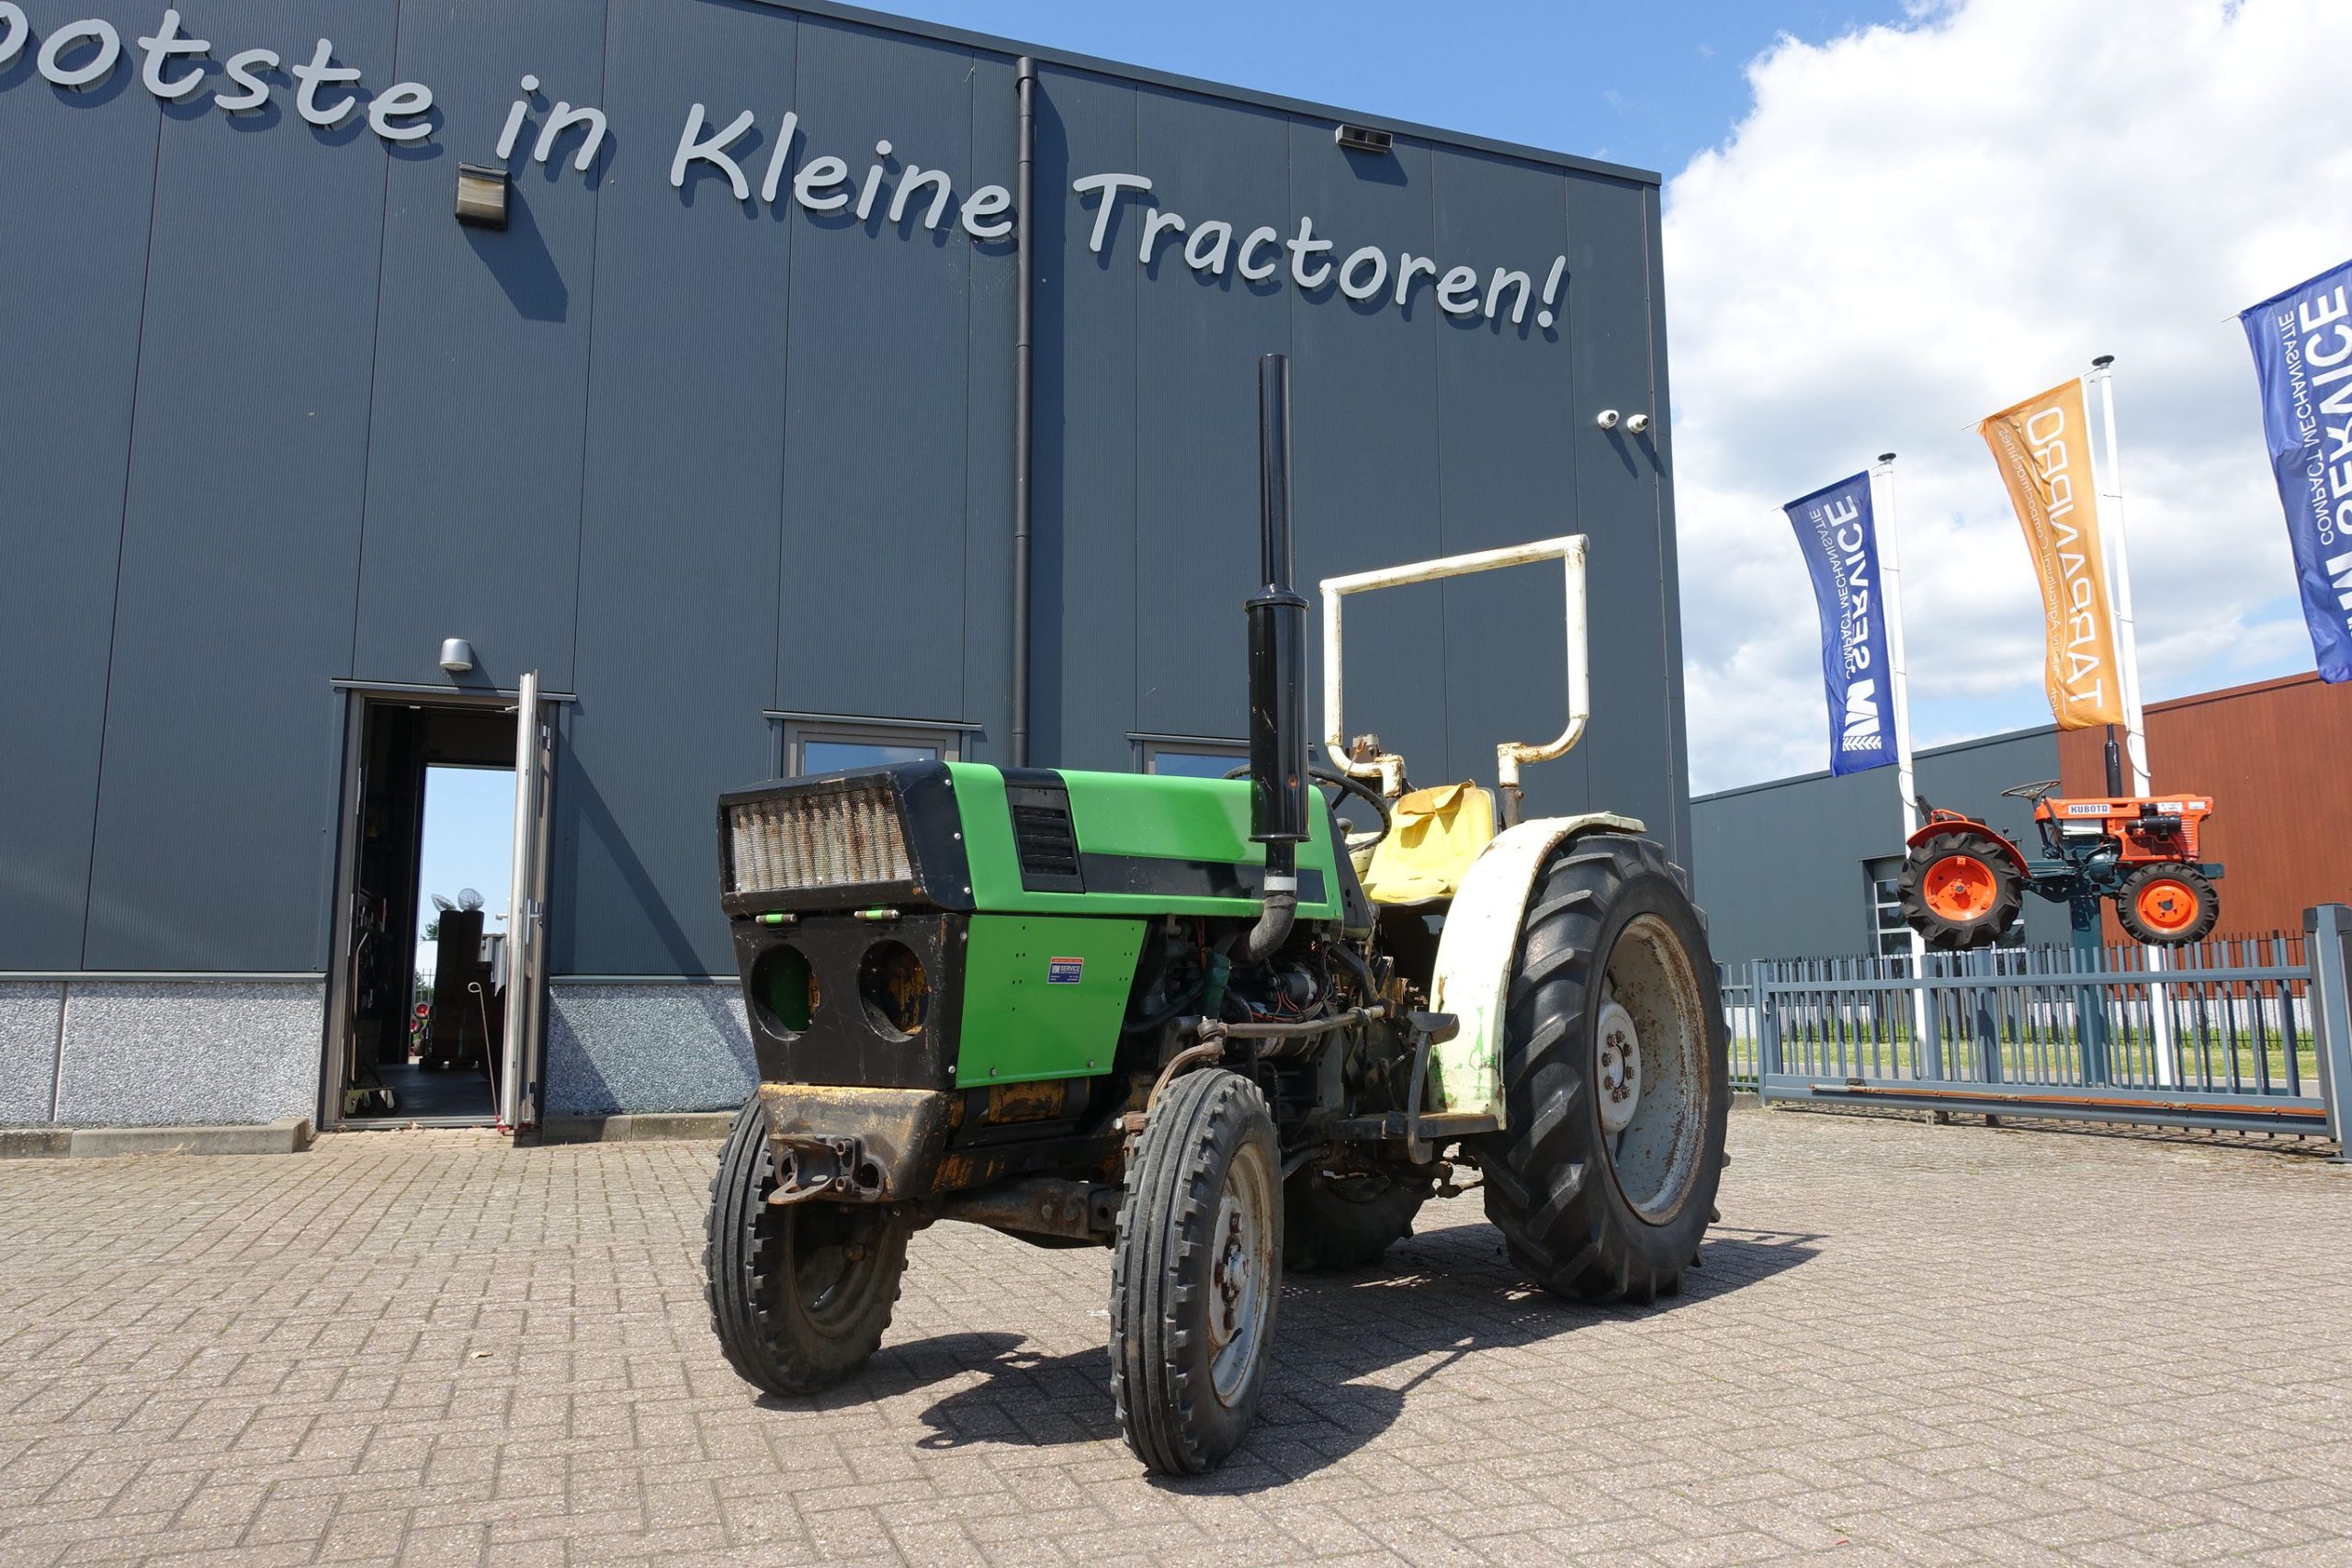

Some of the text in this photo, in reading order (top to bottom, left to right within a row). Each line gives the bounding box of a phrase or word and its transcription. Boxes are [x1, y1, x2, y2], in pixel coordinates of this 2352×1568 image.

[496, 74, 607, 171] in
[671, 103, 1012, 237] Kleine
[1072, 173, 1566, 328] Tractoren!
[2070, 804, 2109, 814] KUBOTA
